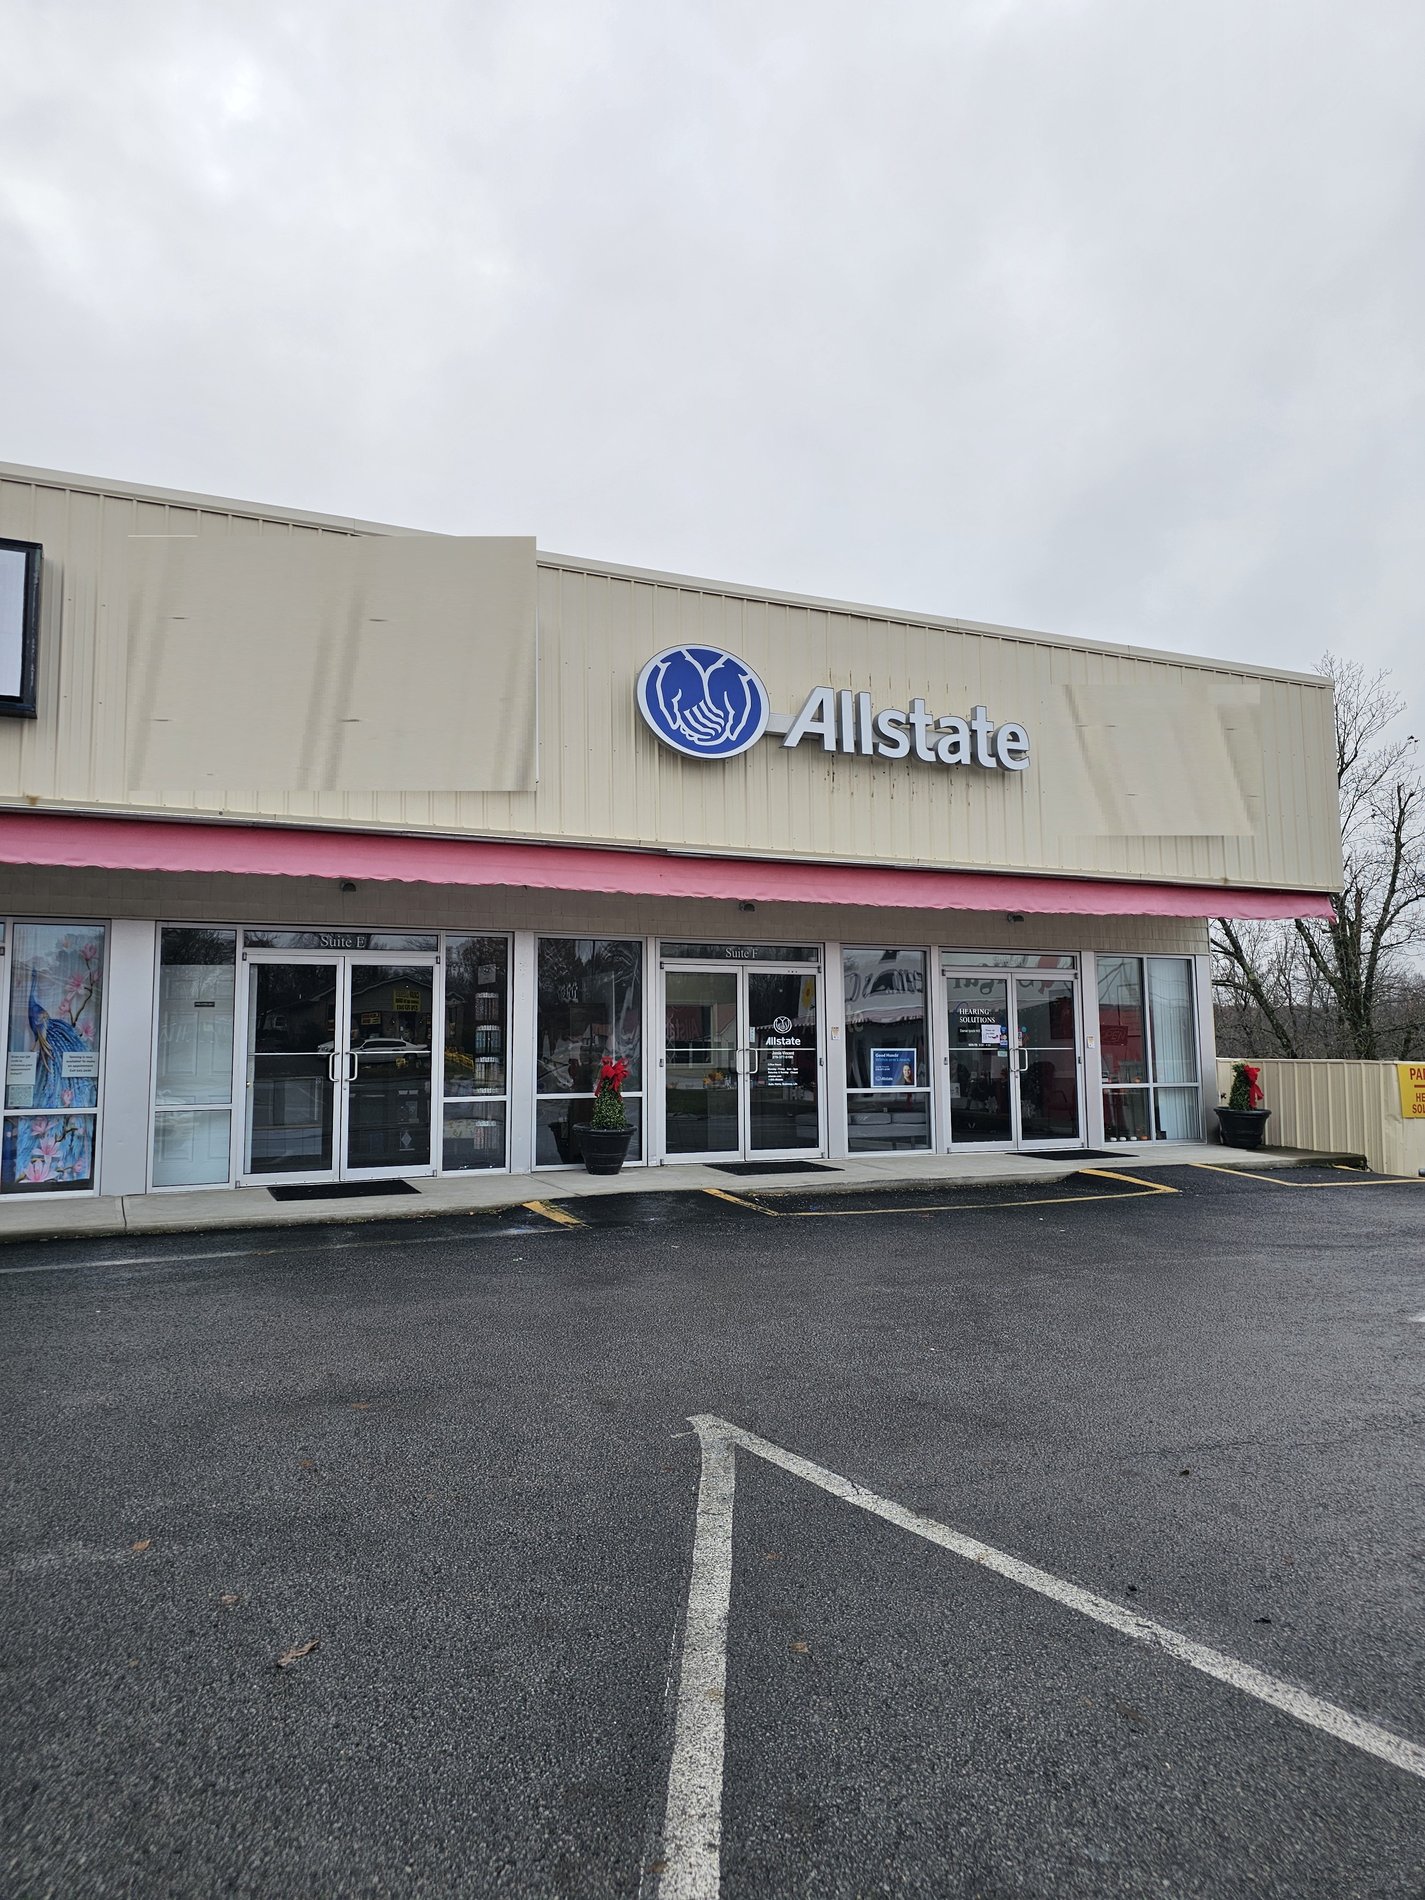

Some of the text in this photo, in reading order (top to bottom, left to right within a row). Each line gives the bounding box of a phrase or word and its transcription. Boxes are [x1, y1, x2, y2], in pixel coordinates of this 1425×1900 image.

[780, 686, 1031, 772] Allstate
[320, 935, 366, 948] Suite E
[725, 947, 758, 959] Suite F
[959, 1016, 996, 1024] SOLUTIONS
[765, 1036, 801, 1046] Allstate
